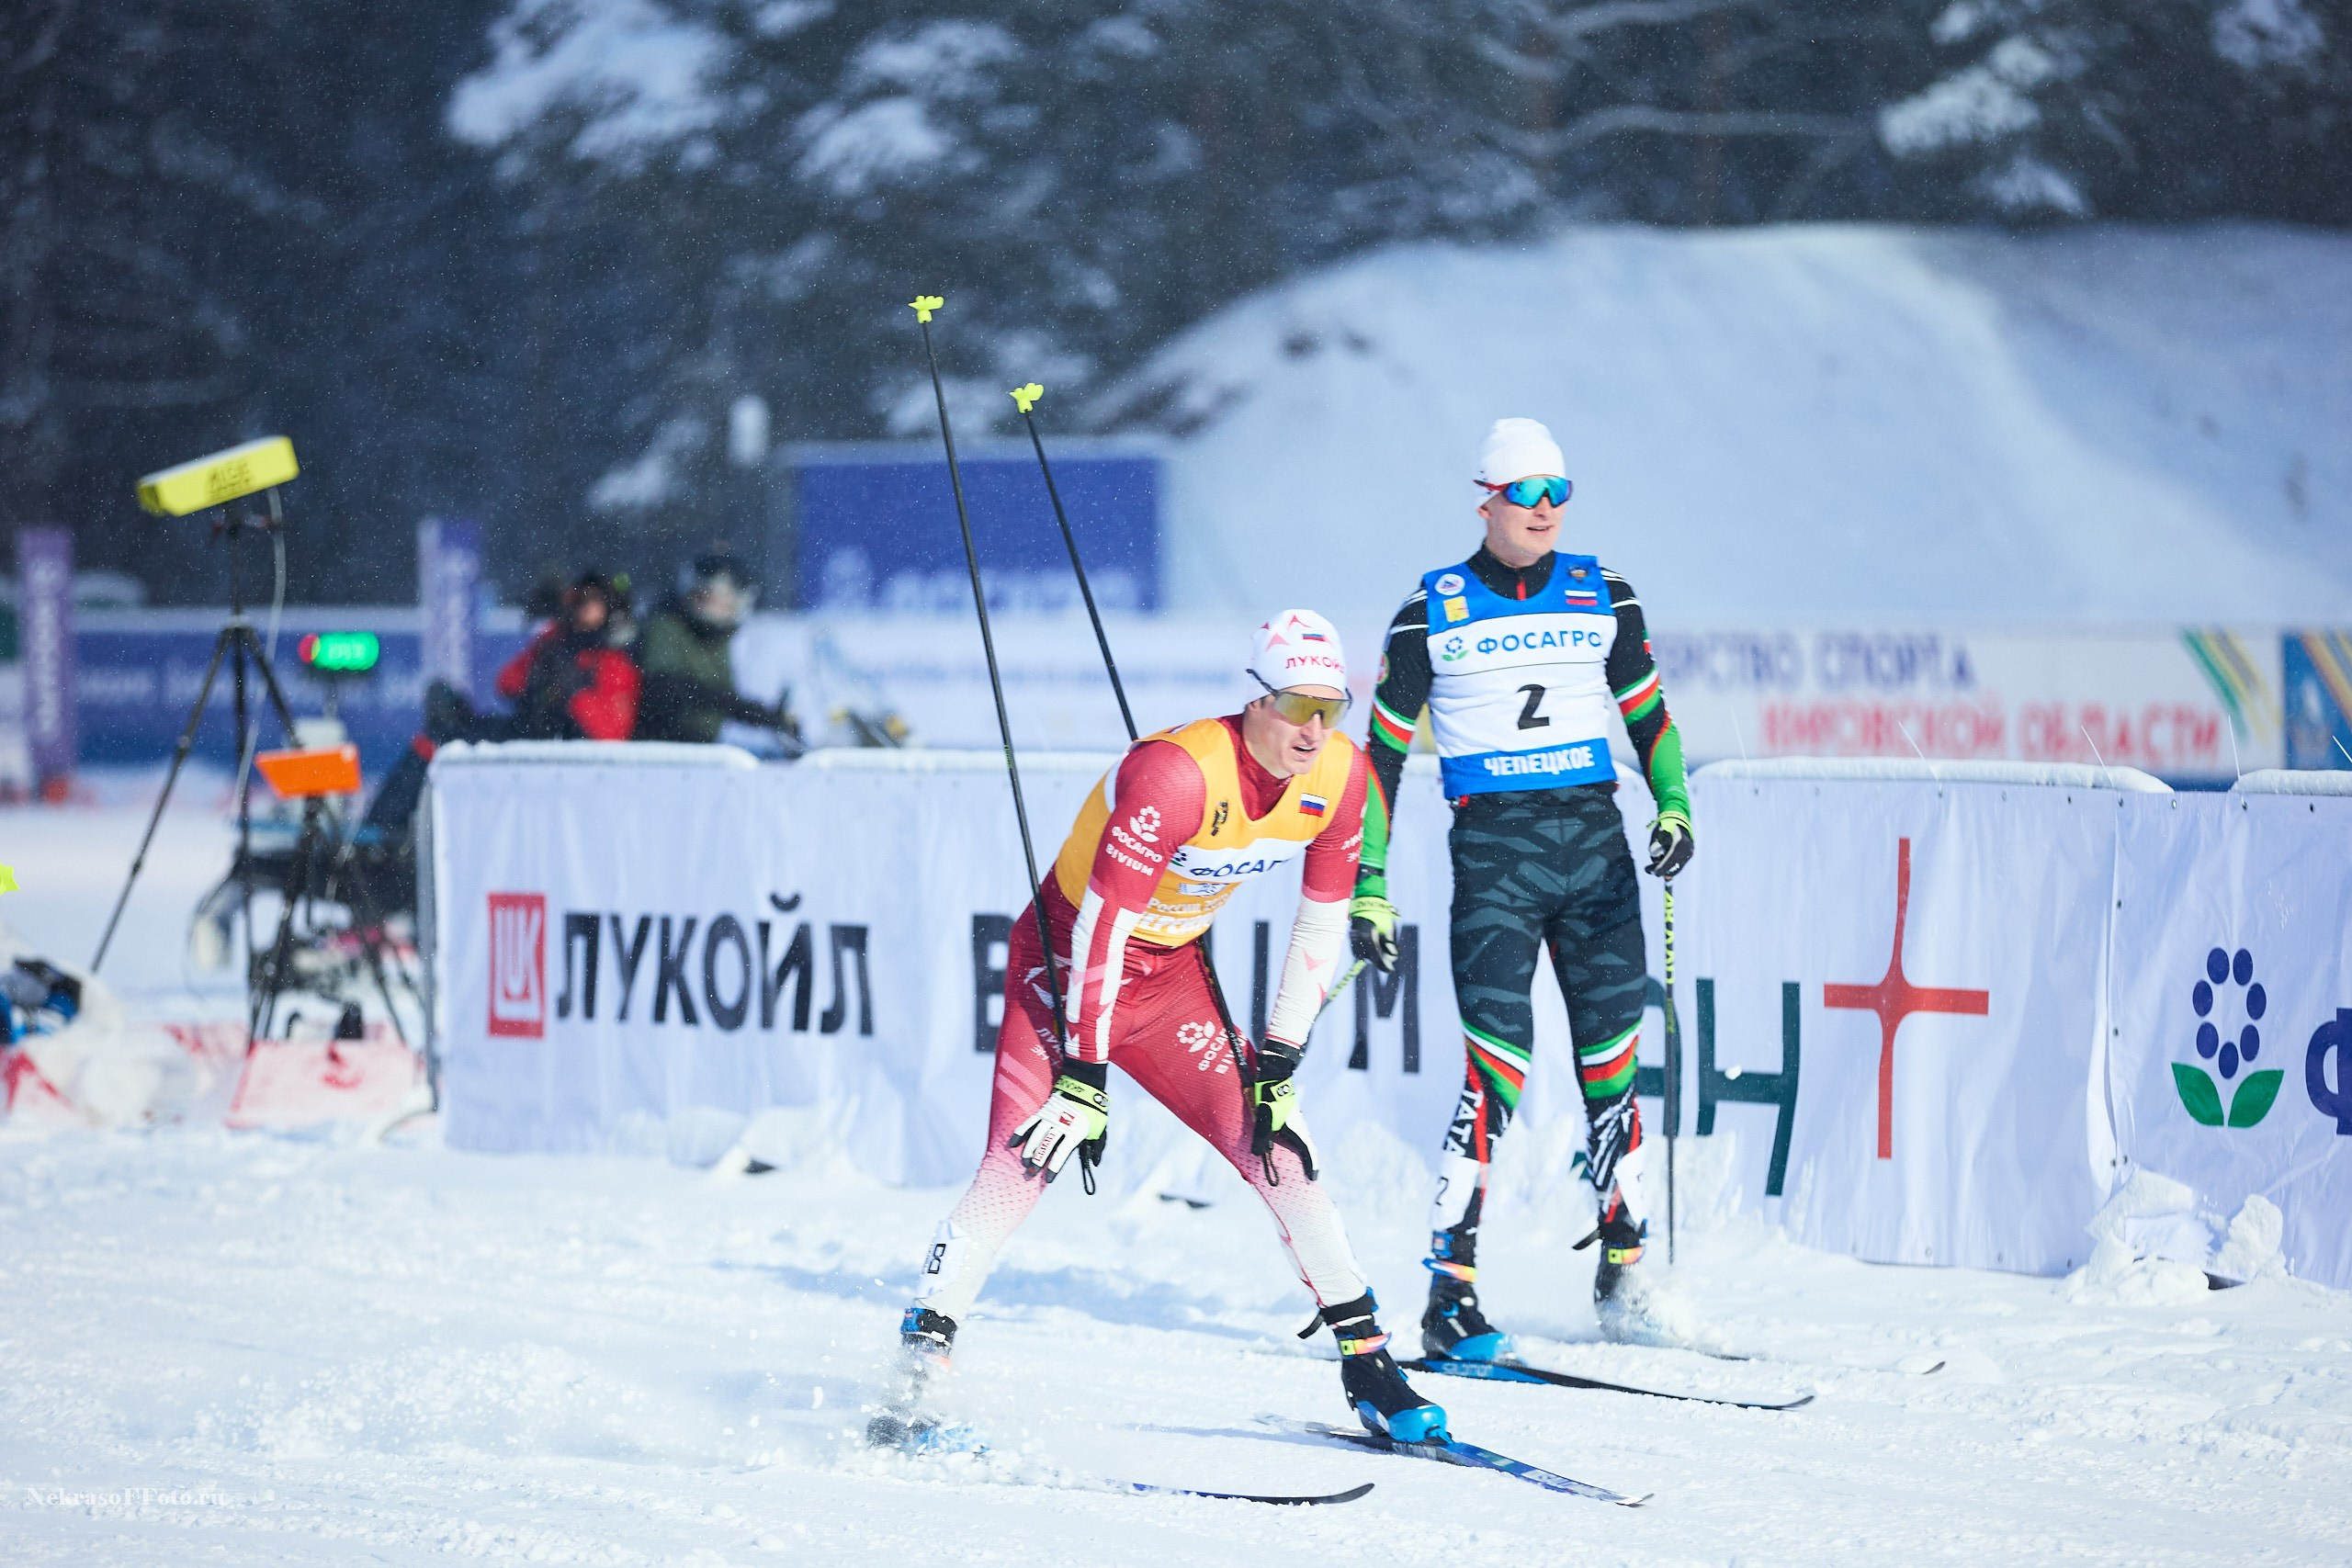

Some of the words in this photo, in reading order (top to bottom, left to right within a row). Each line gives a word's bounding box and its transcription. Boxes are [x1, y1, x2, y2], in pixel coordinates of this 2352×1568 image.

[1815, 629, 1978, 690] СПОРТА
[1517, 683, 1550, 730] 2
[1484, 745, 1595, 775] ЧЕПЕЦКОЕ
[1105, 843, 1154, 876] BIVIUM
[1112, 826, 1163, 863] ФОСАГРО
[557, 890, 874, 1037] ЛУКОЙЛ
